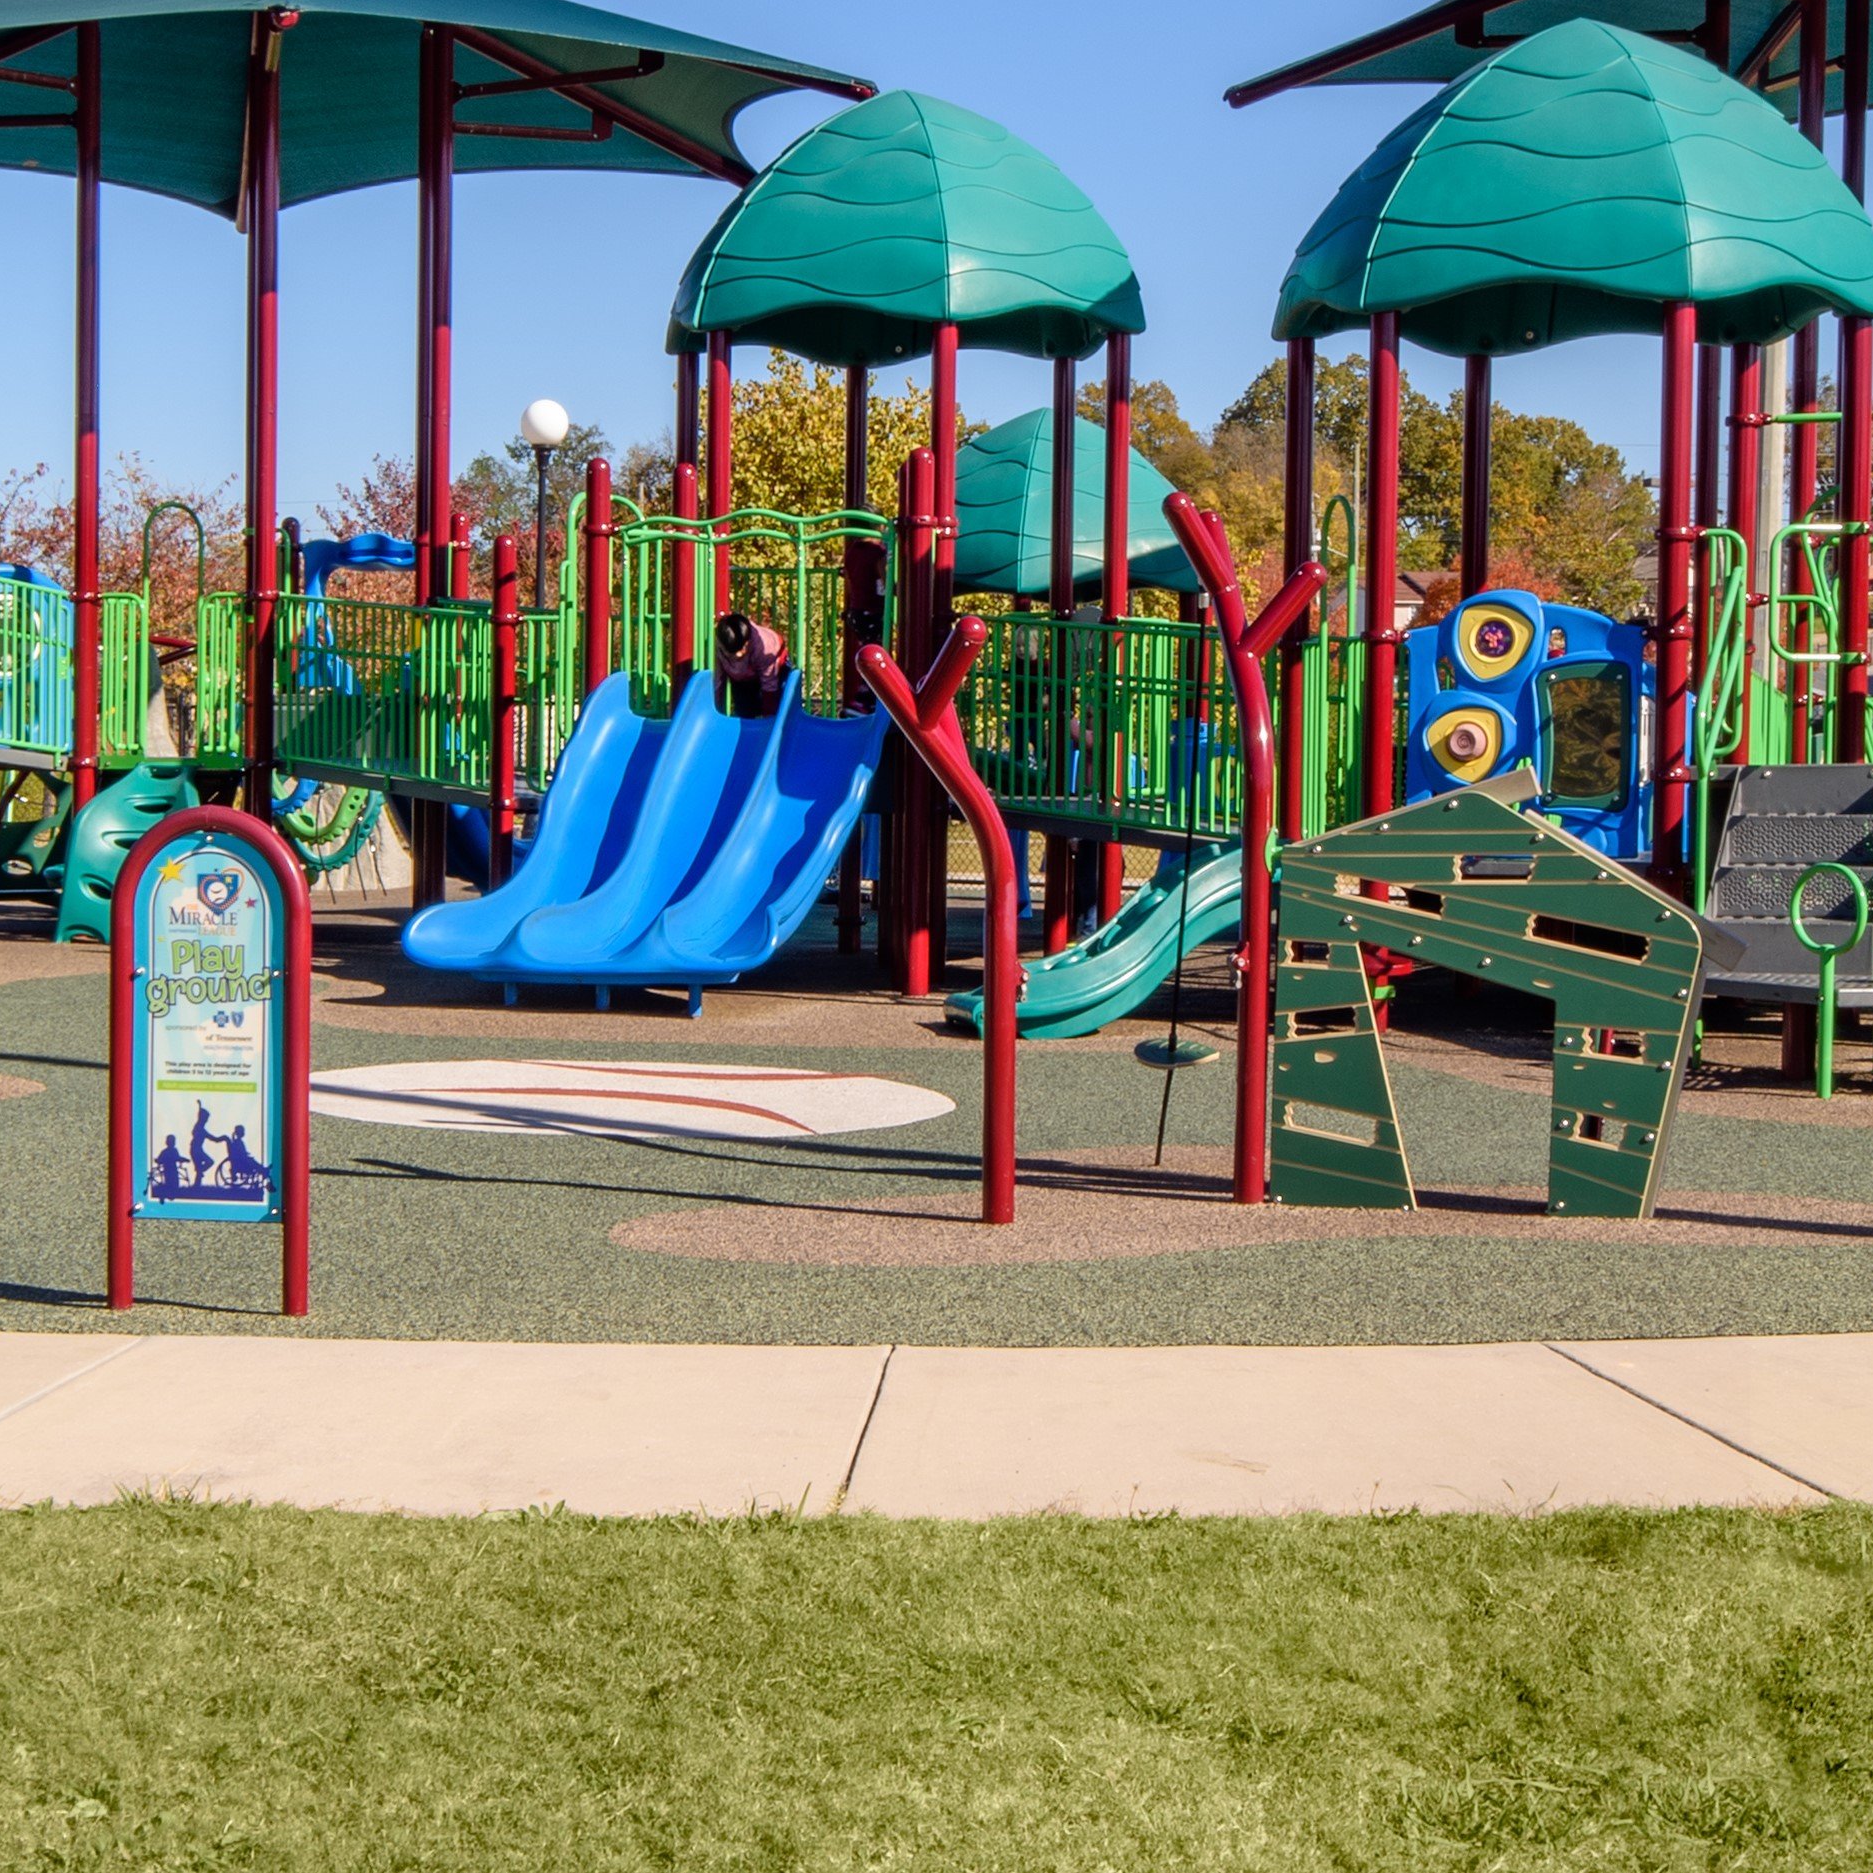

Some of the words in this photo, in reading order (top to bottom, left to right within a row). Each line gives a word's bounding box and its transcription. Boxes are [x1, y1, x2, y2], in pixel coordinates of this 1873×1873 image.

[169, 906, 238, 926] MIRACLE
[198, 926, 236, 936] LEAGUE
[171, 939, 245, 979] Play
[145, 967, 271, 1018] ground
